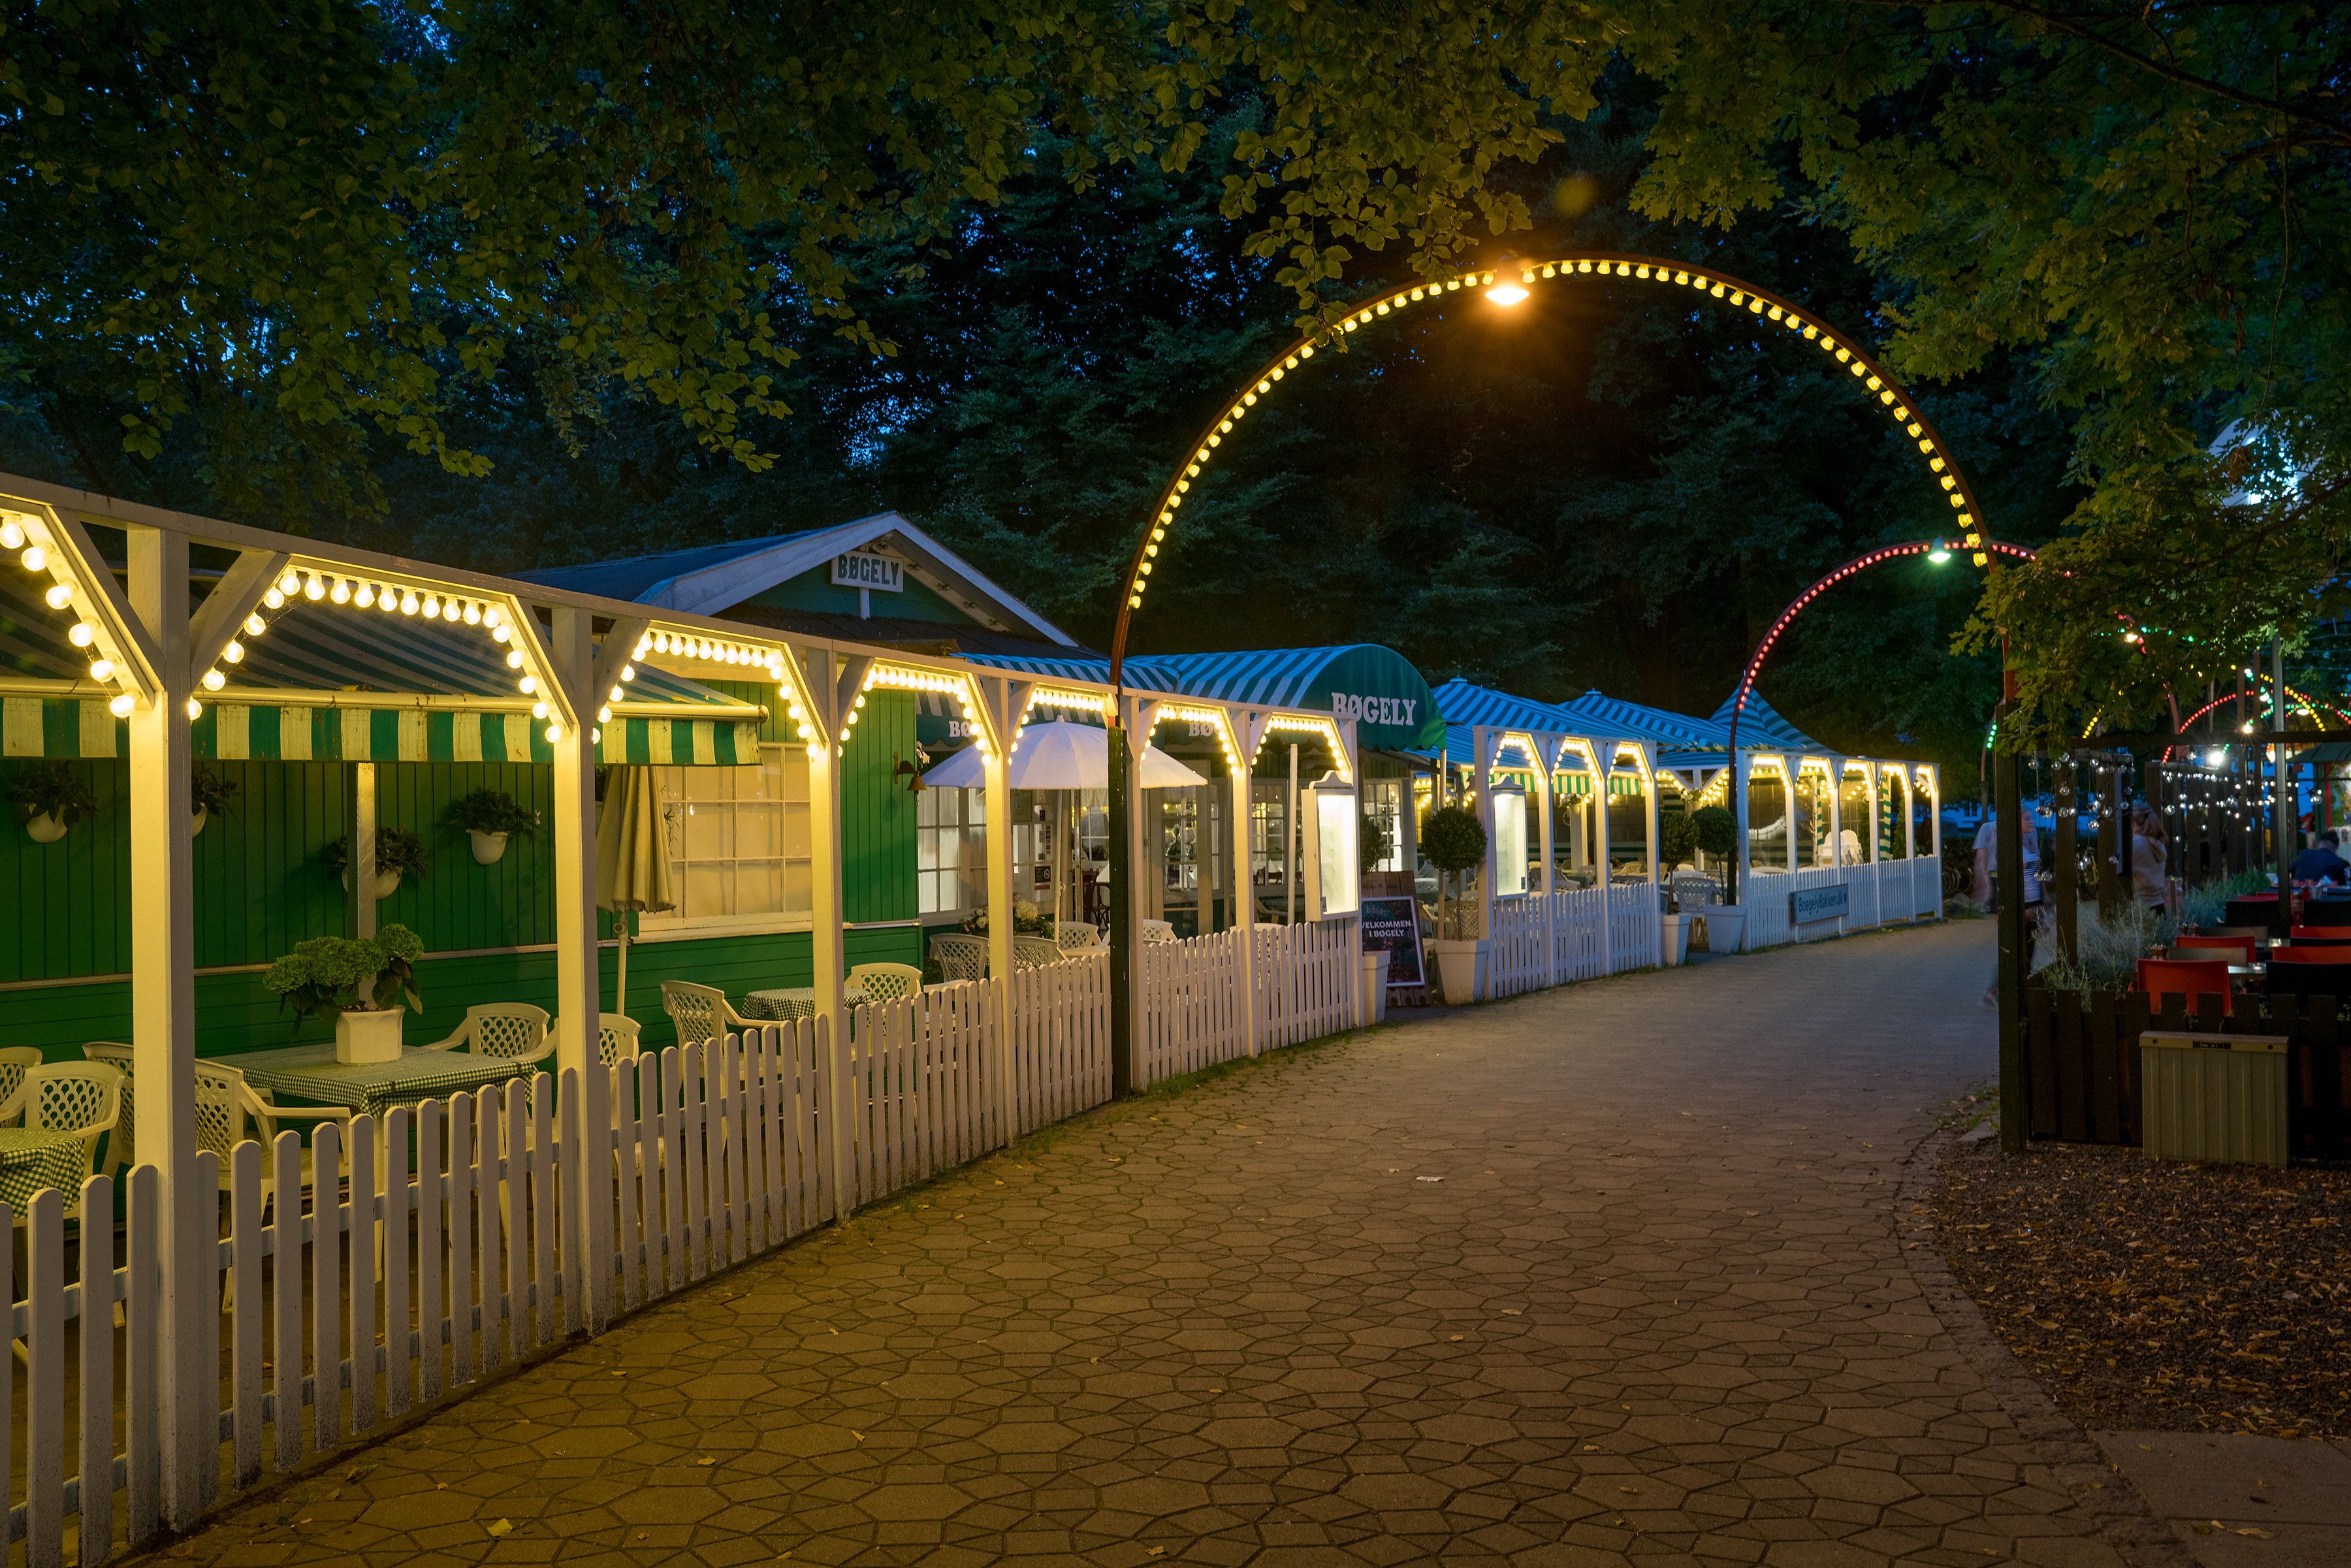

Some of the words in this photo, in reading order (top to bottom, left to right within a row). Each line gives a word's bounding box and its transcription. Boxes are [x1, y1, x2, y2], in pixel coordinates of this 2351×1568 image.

[838, 554, 899, 586] BØGELY
[1332, 692, 1416, 726] BØGELY
[1373, 929, 1404, 938] BØGELY
